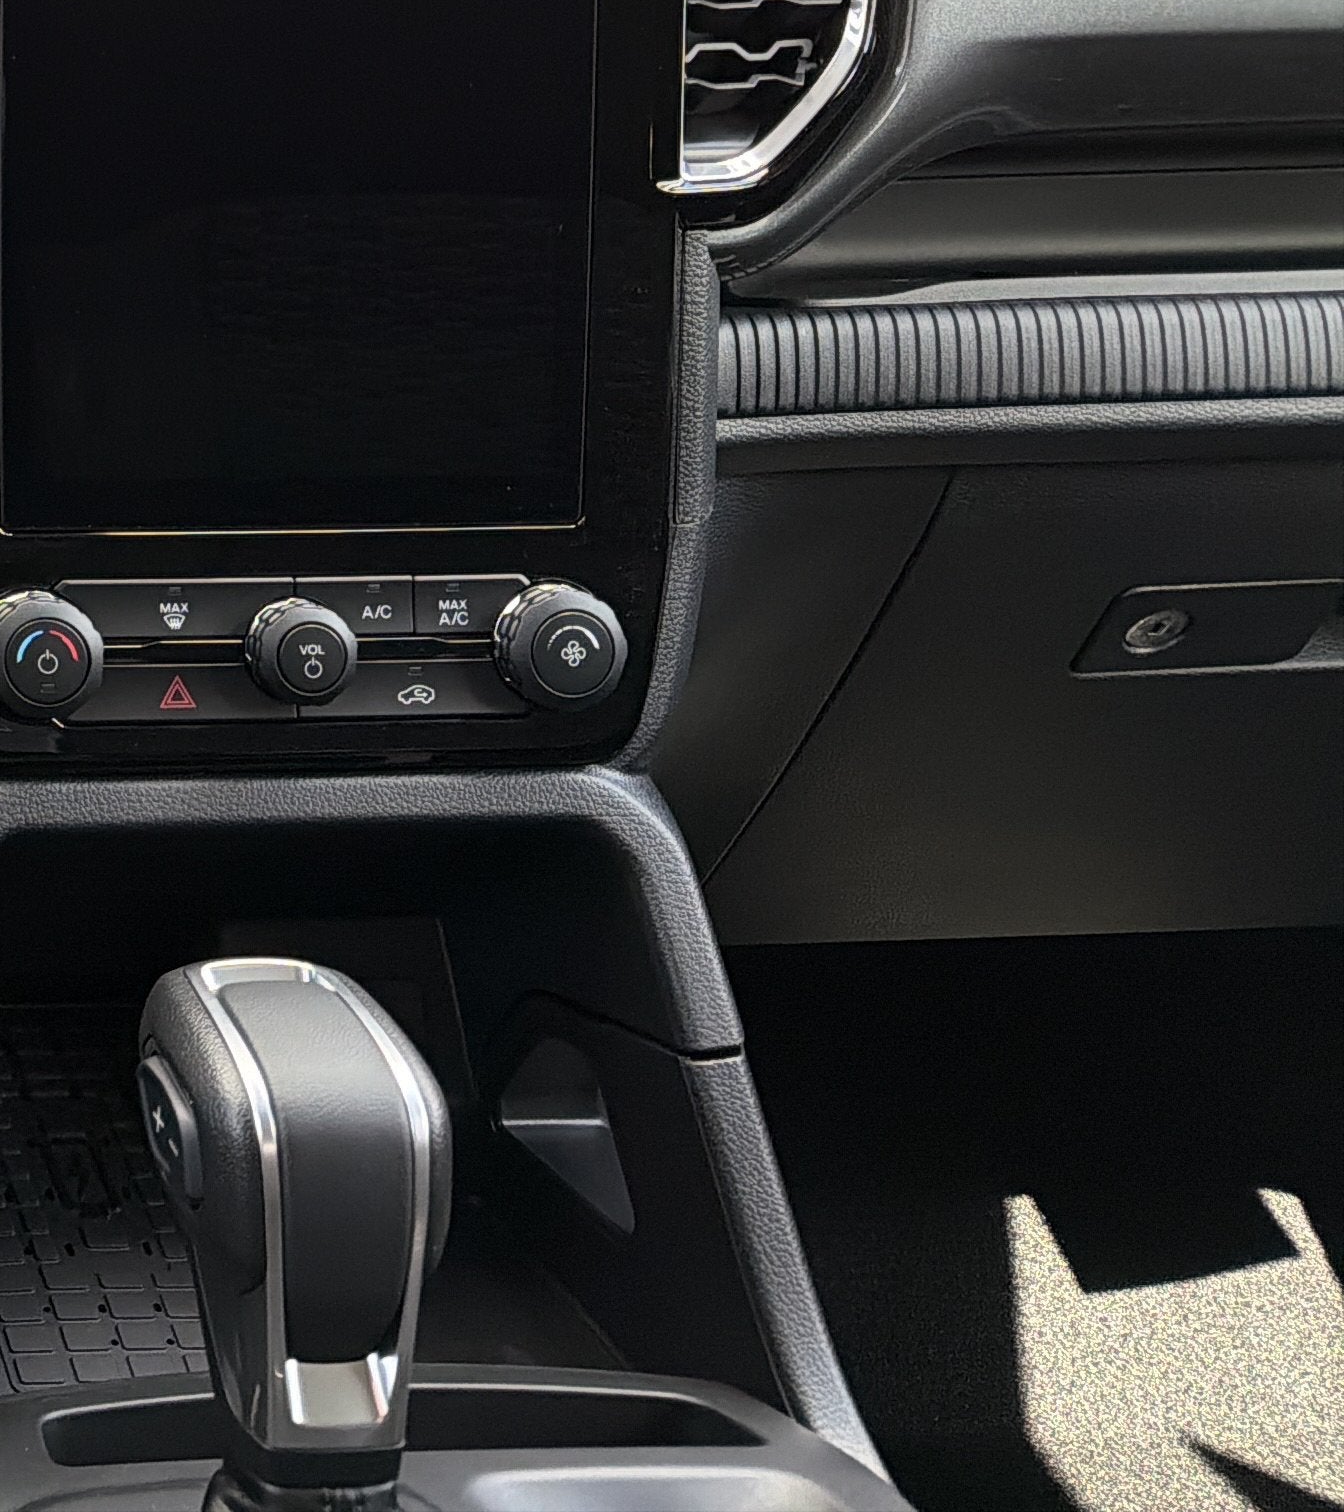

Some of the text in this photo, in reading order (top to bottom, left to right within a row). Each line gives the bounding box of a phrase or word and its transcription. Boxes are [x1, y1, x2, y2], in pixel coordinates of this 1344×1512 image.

[159, 602, 189, 614] MAX
[438, 599, 468, 610] MAX
[362, 605, 393, 620] A/C
[438, 612, 469, 626] A/C
[299, 644, 326, 656] VOL
